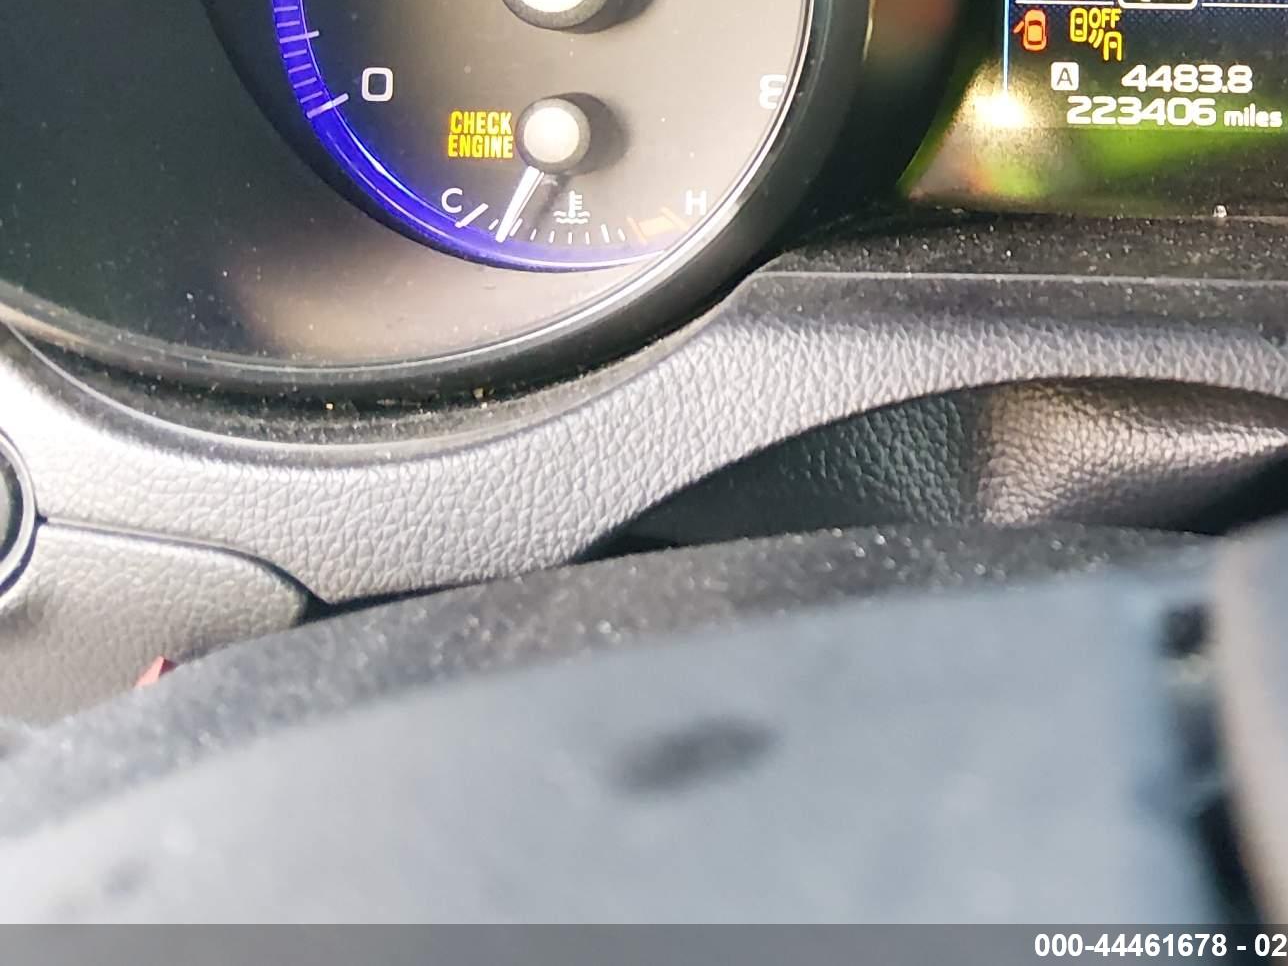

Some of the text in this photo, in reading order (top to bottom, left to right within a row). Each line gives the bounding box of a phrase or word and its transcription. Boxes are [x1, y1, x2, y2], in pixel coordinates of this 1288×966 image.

[1088, 7, 1123, 29] OFF
[361, 68, 394, 103] 0
[1056, 63, 1254, 94] A 4483.8
[450, 111, 512, 135] CHECK
[1066, 95, 1284, 128] 223406 miles
[448, 135, 514, 159] ENGINE
[441, 188, 463, 214] C
[684, 190, 708, 216] H
